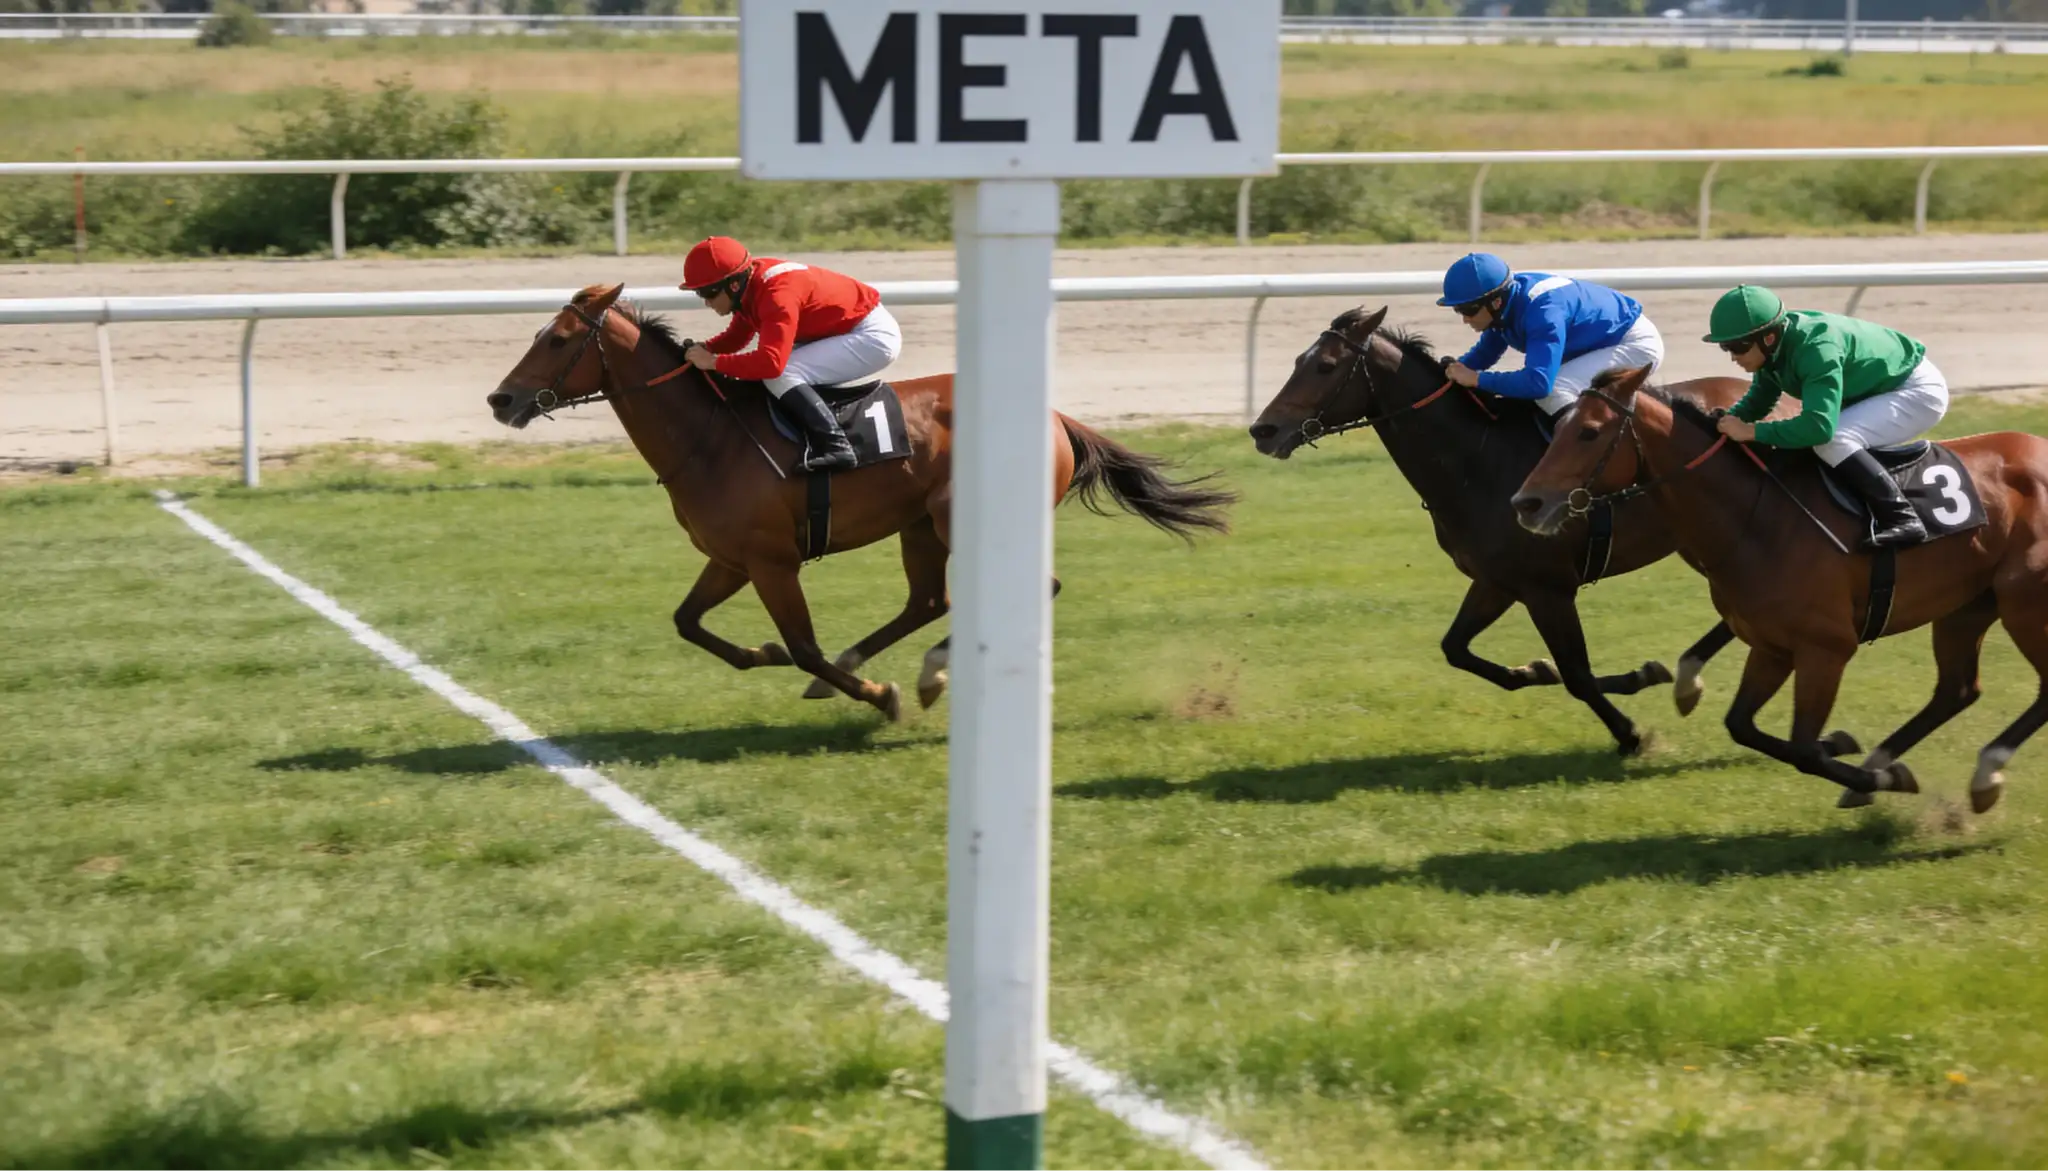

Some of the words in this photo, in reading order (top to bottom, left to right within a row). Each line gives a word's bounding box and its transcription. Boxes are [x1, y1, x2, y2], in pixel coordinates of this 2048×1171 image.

[795, 11, 1240, 144] META
[864, 400, 894, 454] 1
[1922, 464, 1972, 526] 3
